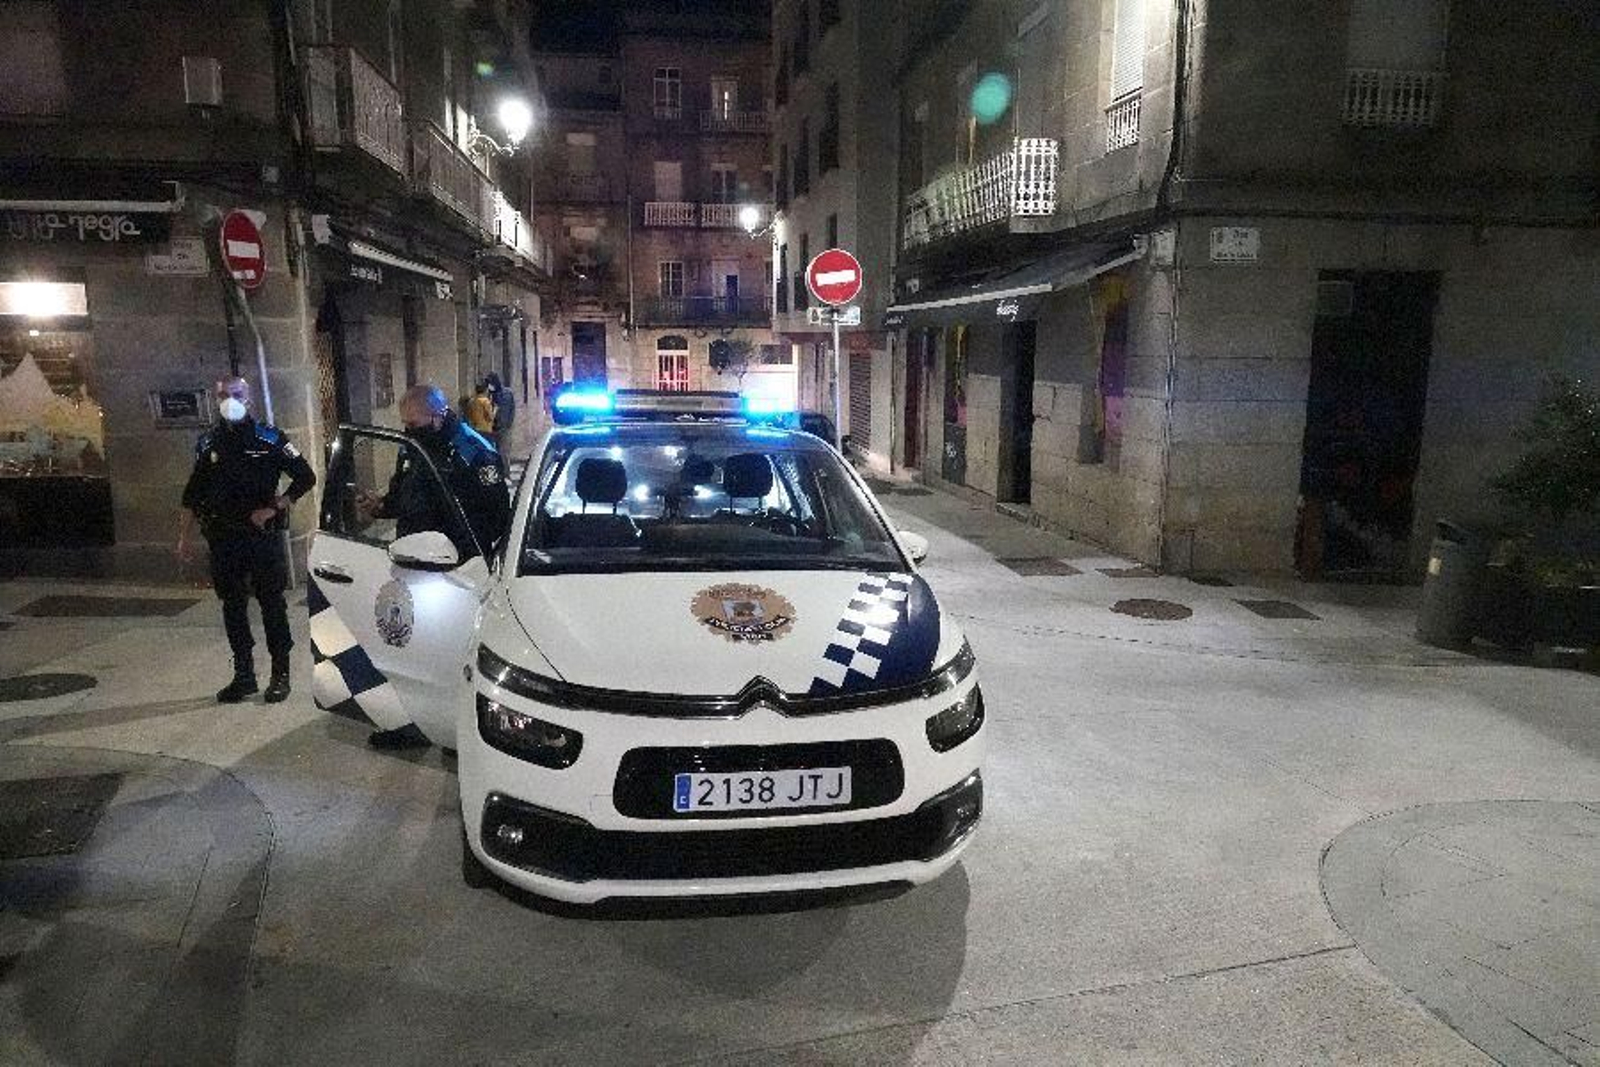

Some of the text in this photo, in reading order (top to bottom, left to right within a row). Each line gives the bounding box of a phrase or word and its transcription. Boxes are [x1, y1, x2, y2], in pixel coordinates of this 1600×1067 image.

[68, 213, 140, 241] negra
[697, 773, 843, 806] 2138 JTJ
